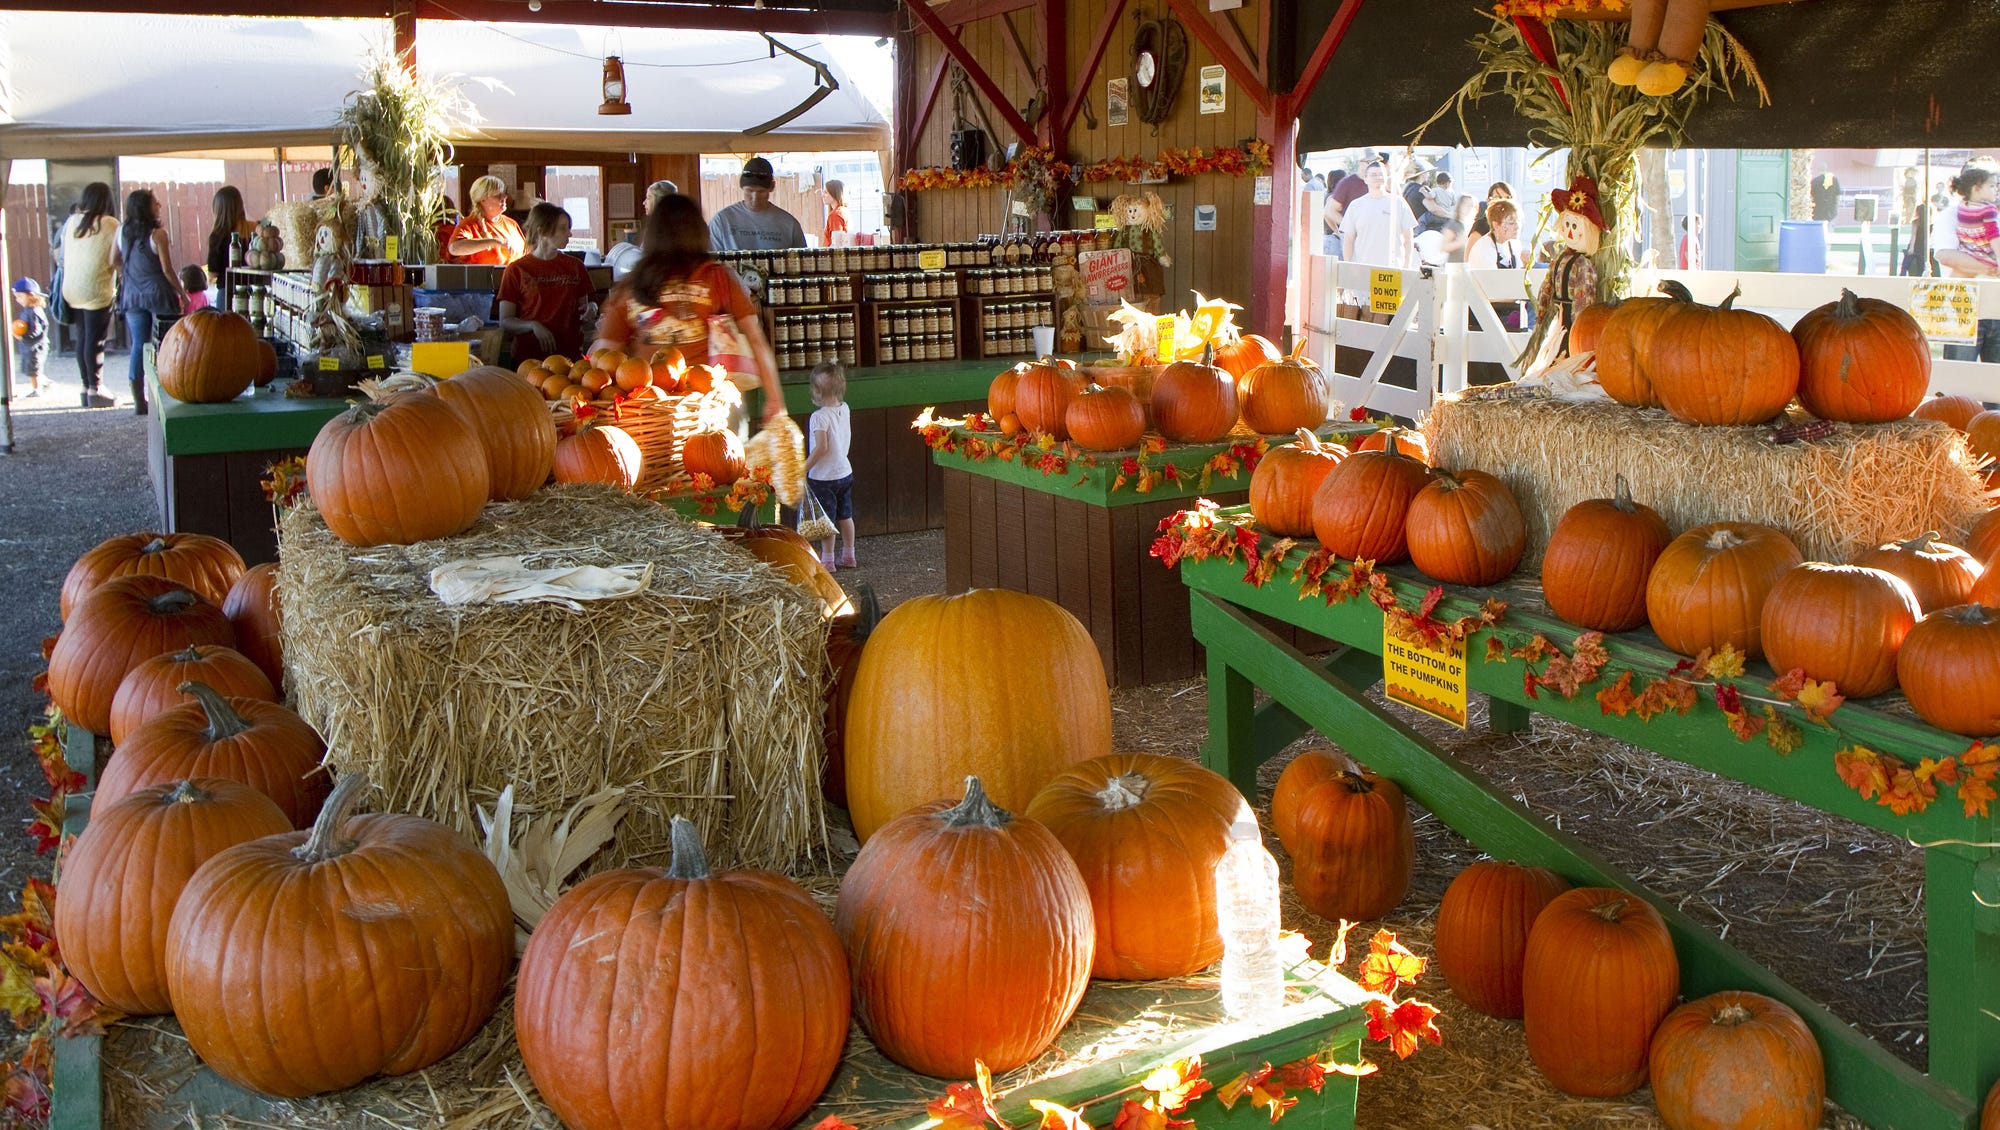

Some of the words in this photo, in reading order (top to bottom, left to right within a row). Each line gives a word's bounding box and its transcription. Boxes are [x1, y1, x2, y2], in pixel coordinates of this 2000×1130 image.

[1089, 252, 1119, 273] GIANT
[1378, 273, 1393, 282] EXIT
[1373, 287, 1383, 295] DO
[1384, 288, 1398, 297] NOT
[1913, 283, 1948, 291] PUMKIN
[1375, 301, 1397, 311] ENTER
[1931, 316, 1971, 325] PUMINS
[1387, 643, 1405, 658] THE
[1407, 648, 1446, 671] BOTTOM
[1448, 664, 1462, 677] OF
[1390, 660, 1408, 675] THE
[1410, 668, 1460, 694] PUMPKINS
